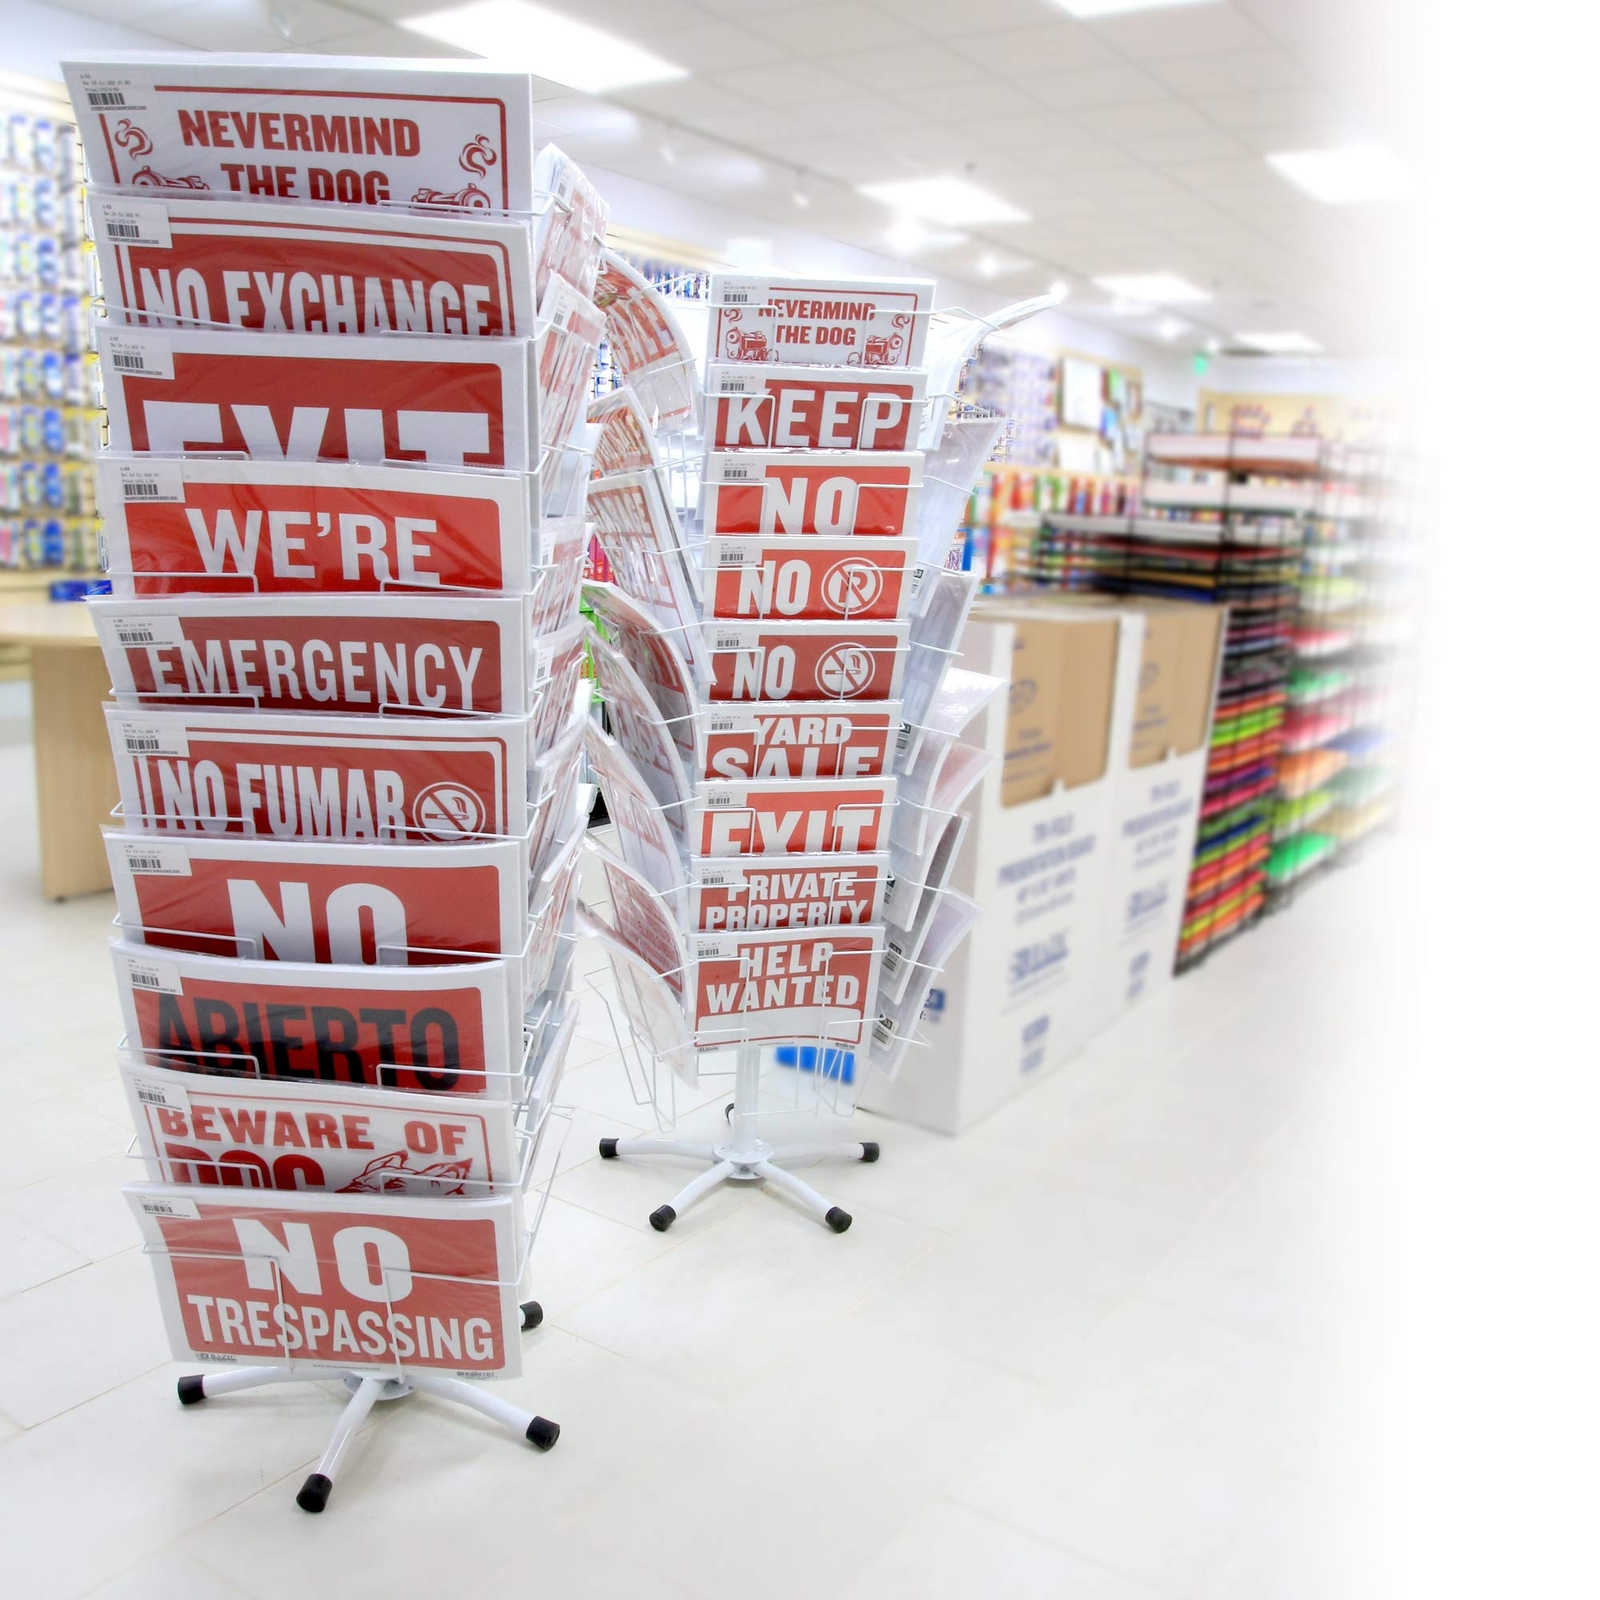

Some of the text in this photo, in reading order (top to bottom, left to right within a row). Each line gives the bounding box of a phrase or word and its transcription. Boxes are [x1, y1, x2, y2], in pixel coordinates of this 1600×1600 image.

[177, 109, 421, 157] NEVERMIND
[221, 163, 390, 205] THE DOG
[139, 267, 491, 336] NO EXCHANGE
[758, 299, 876, 321] NEVERMIND
[776, 325, 856, 346] THE DOG
[724, 388, 903, 448] KEEP
[764, 476, 858, 535] NO
[737, 559, 812, 616] NO
[148, 639, 482, 710] EMERGENCY
[732, 645, 796, 700] NO
[753, 717, 852, 746] YARD
[712, 747, 879, 780] SALE
[158, 759, 406, 839] NO FUMAR
[710, 809, 875, 857] EXIT
[727, 871, 858, 902] PRIVATE
[227, 879, 408, 965] NO
[705, 900, 868, 932] PROPERTY
[738, 942, 833, 979] HELP
[705, 975, 860, 1014] WANTED
[157, 994, 460, 1090] ABIERTO
[159, 1105, 467, 1156] BEWARE OF
[232, 1218, 413, 1303] NO
[187, 1294, 494, 1361] TRESPASSING
